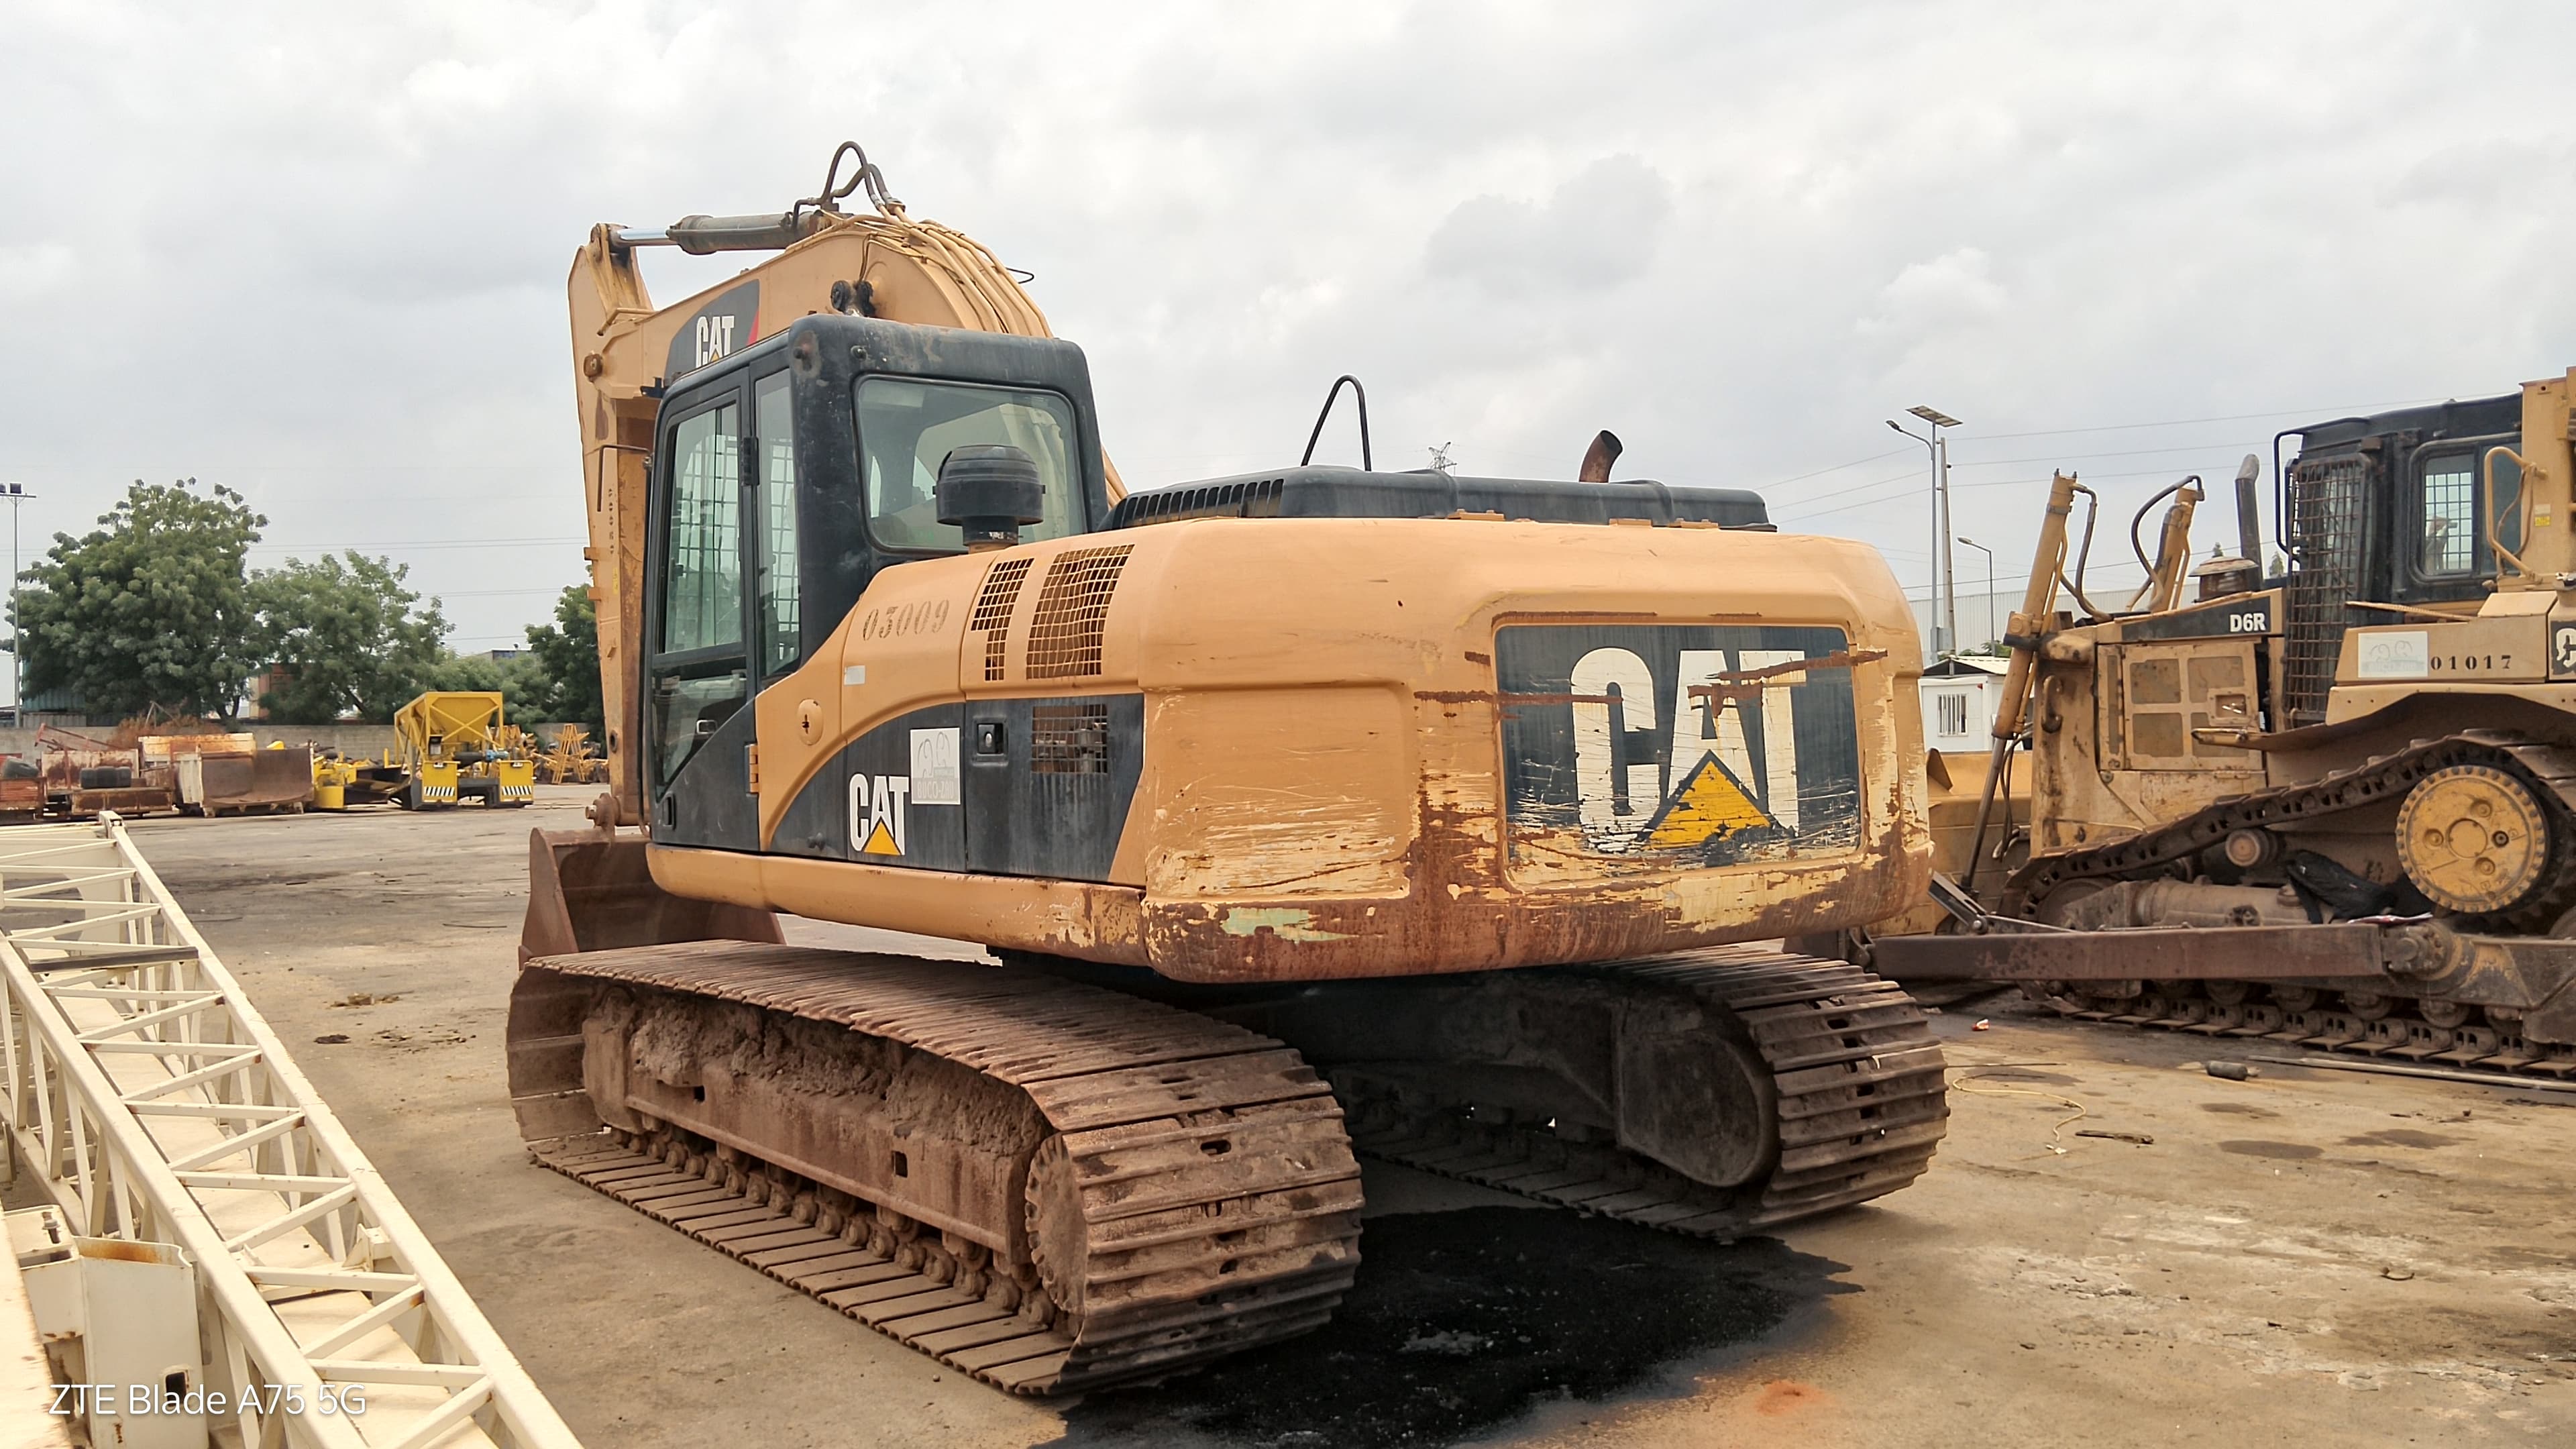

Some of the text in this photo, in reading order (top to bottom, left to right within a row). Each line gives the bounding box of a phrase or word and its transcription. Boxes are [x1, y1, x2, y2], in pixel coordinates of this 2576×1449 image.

[696, 315, 735, 368] CAT
[863, 599, 949, 641] 03009
[2229, 612, 2266, 632] D6R
[2430, 655, 2511, 670] 01017
[1570, 647, 1807, 853] CAT
[849, 773, 909, 855] CAT
